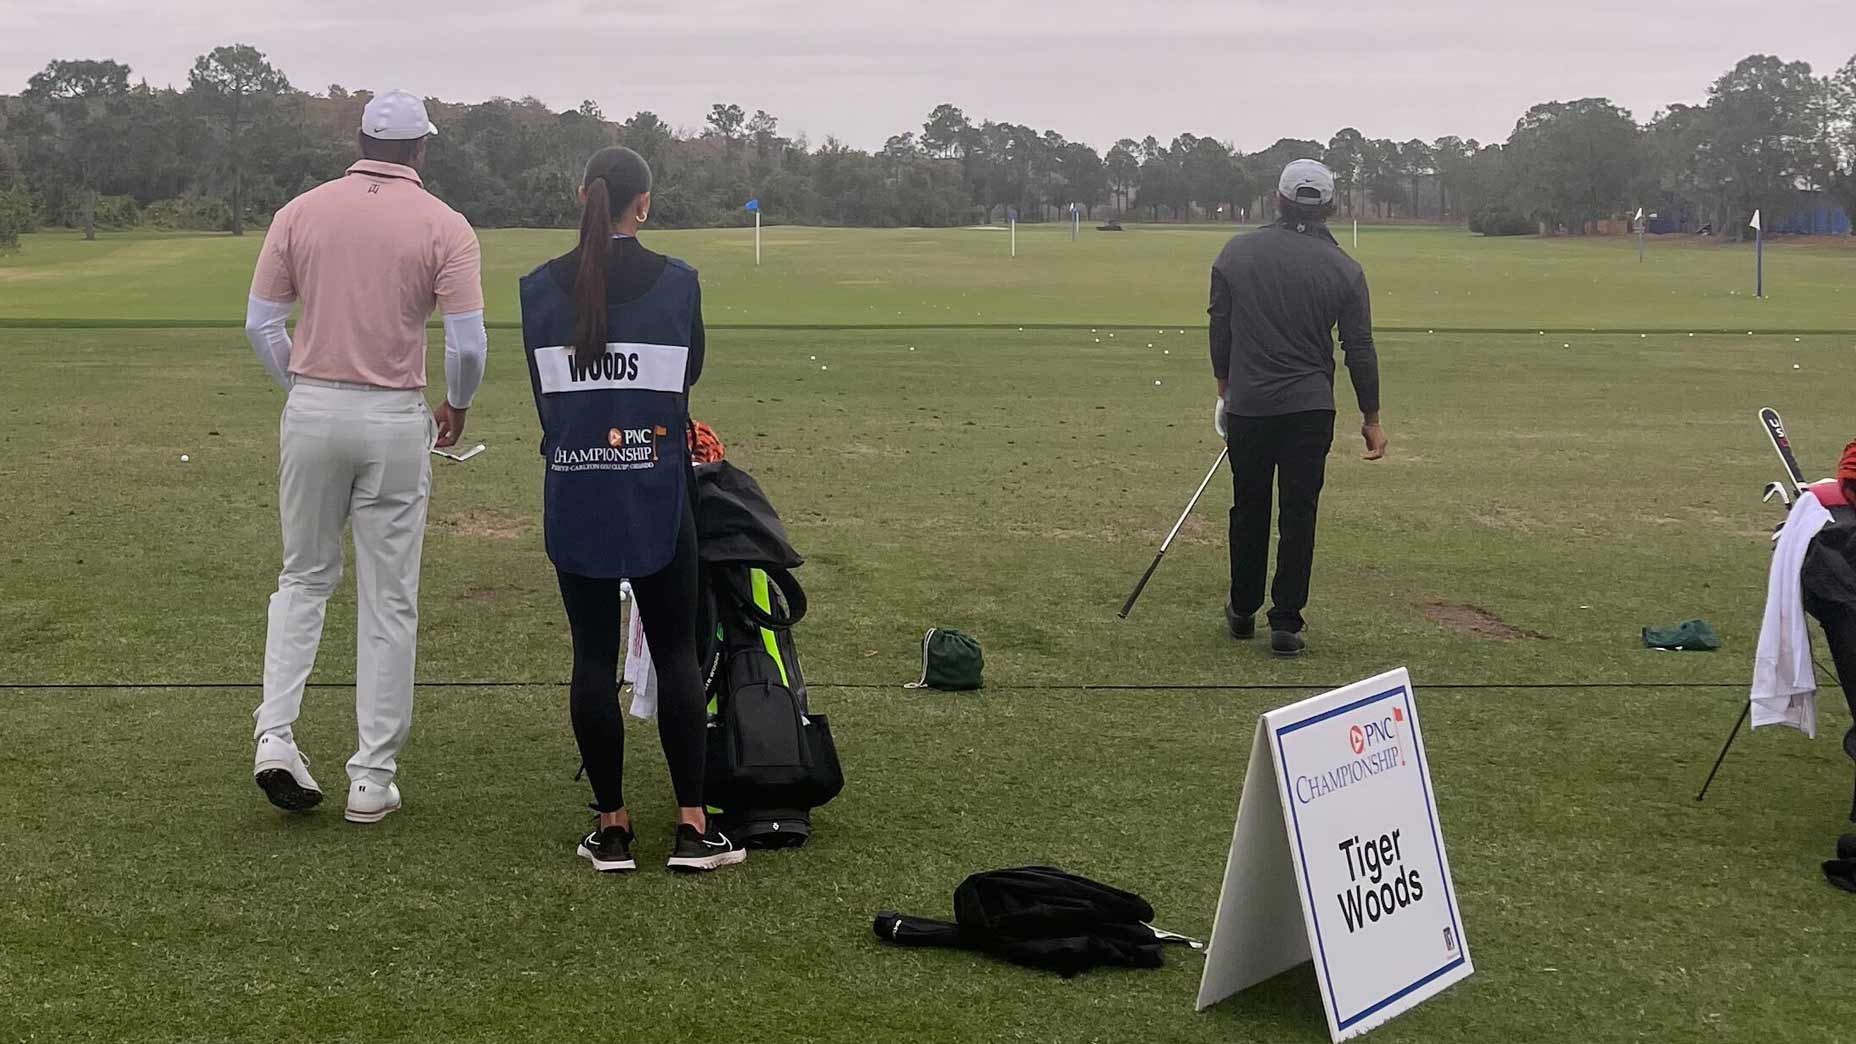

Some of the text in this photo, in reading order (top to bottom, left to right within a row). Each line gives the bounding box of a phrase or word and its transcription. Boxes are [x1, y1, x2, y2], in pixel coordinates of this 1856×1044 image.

[568, 352, 639, 382] WOODS
[624, 429, 652, 444] PNC
[554, 446, 652, 463] CHAMPIONSHIP
[1364, 717, 1394, 747] PNC
[1296, 746, 1399, 804] CHAMPIONSHIP
[1338, 828, 1400, 884] Tiger
[1337, 864, 1423, 933] Woods
